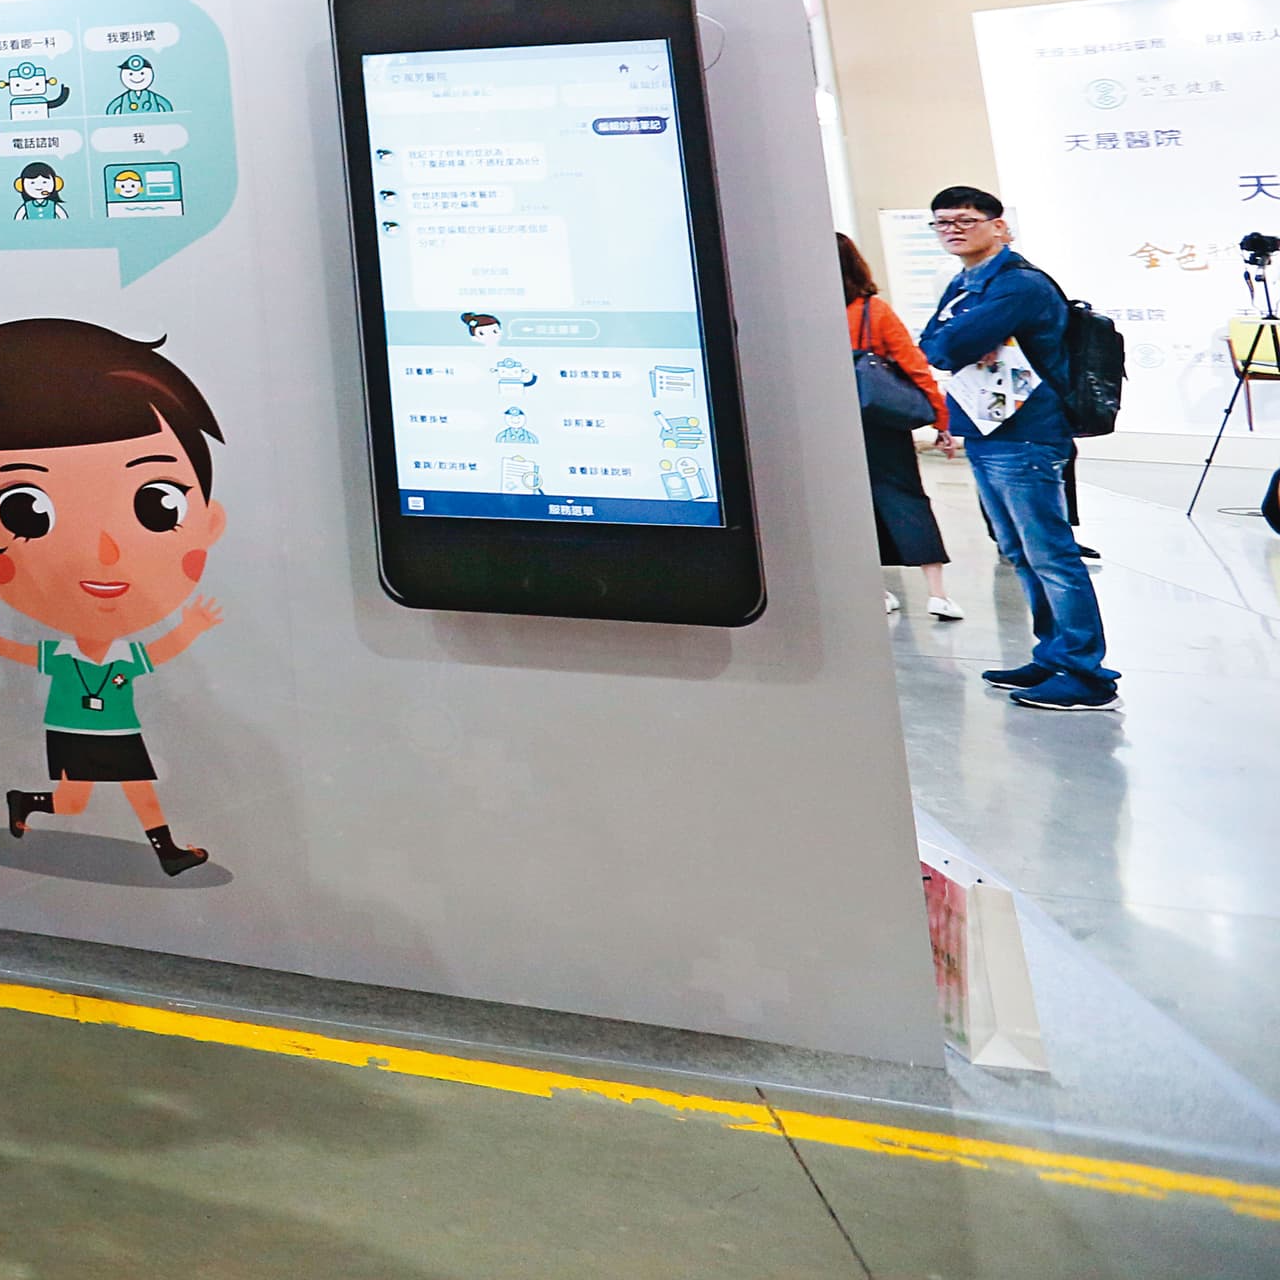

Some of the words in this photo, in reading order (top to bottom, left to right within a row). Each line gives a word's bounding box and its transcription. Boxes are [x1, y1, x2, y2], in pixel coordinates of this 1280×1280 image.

[106, 29, 156, 44] 我要掛號
[12, 136, 60, 150] 電話諮詢
[133, 132, 145, 144] 我
[1064, 129, 1184, 152] 天晟醫院
